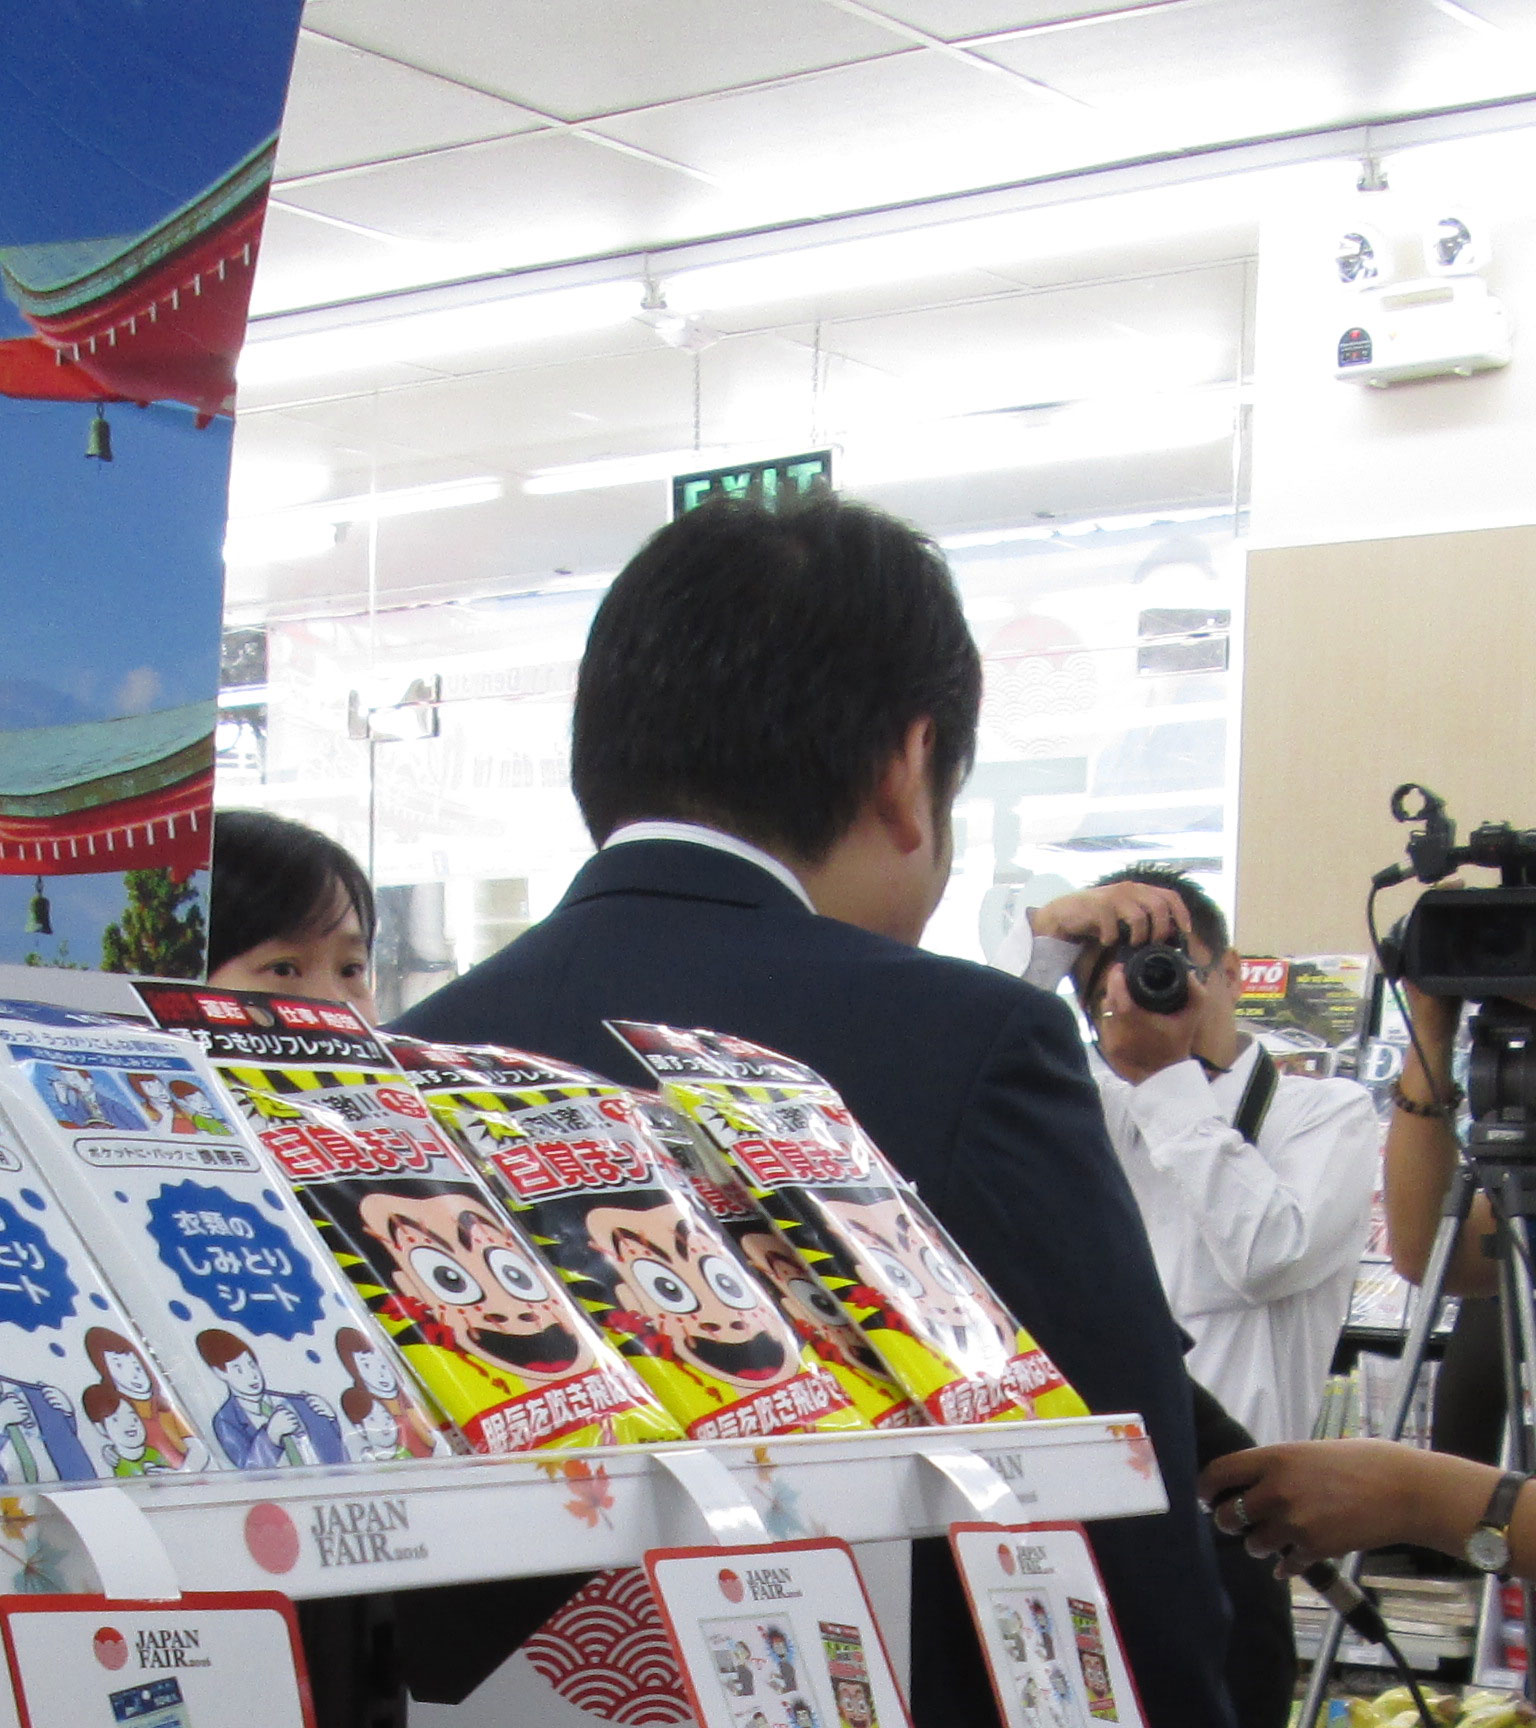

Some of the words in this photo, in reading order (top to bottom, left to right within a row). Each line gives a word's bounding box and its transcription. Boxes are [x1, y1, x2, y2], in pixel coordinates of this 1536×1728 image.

[684, 461, 822, 515] EXIT
[277, 1005, 321, 1026] 仕事
[176, 1209, 254, 1242] 衣類の
[177, 1243, 294, 1278] しみとり
[215, 1280, 302, 1314] シート
[311, 1500, 410, 1538] JAPAN
[318, 1533, 395, 1568] FAIR
[745, 1568, 791, 1588] JAPAN
[135, 1629, 201, 1653] JAPAN
[137, 1648, 188, 1670] FAIR
